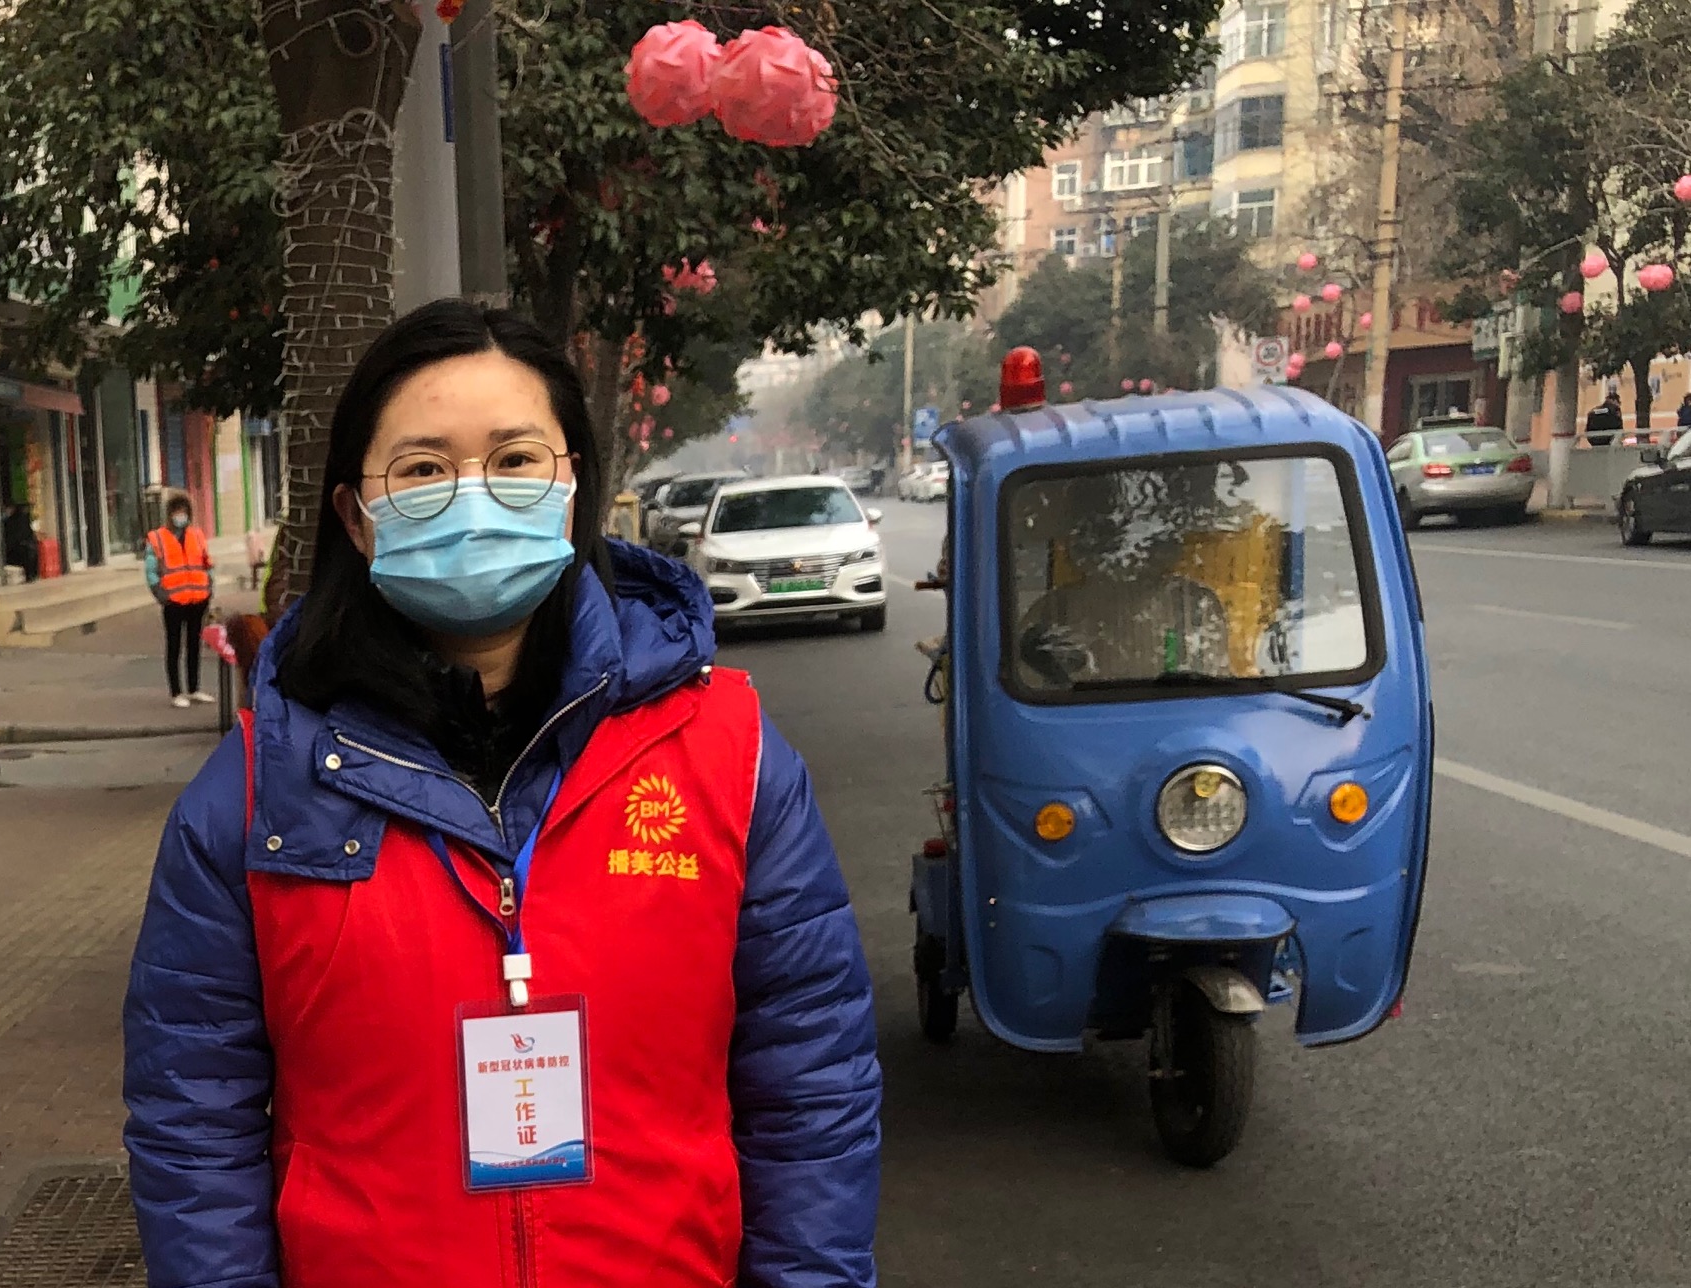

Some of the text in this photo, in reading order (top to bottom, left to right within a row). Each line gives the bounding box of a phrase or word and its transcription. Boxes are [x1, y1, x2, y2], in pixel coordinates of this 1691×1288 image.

[640, 800, 670, 818] BM
[608, 848, 700, 880] 播美公益
[477, 1055, 570, 1073] 新型冠状病毒防控
[514, 1078, 538, 1145] 工作证
